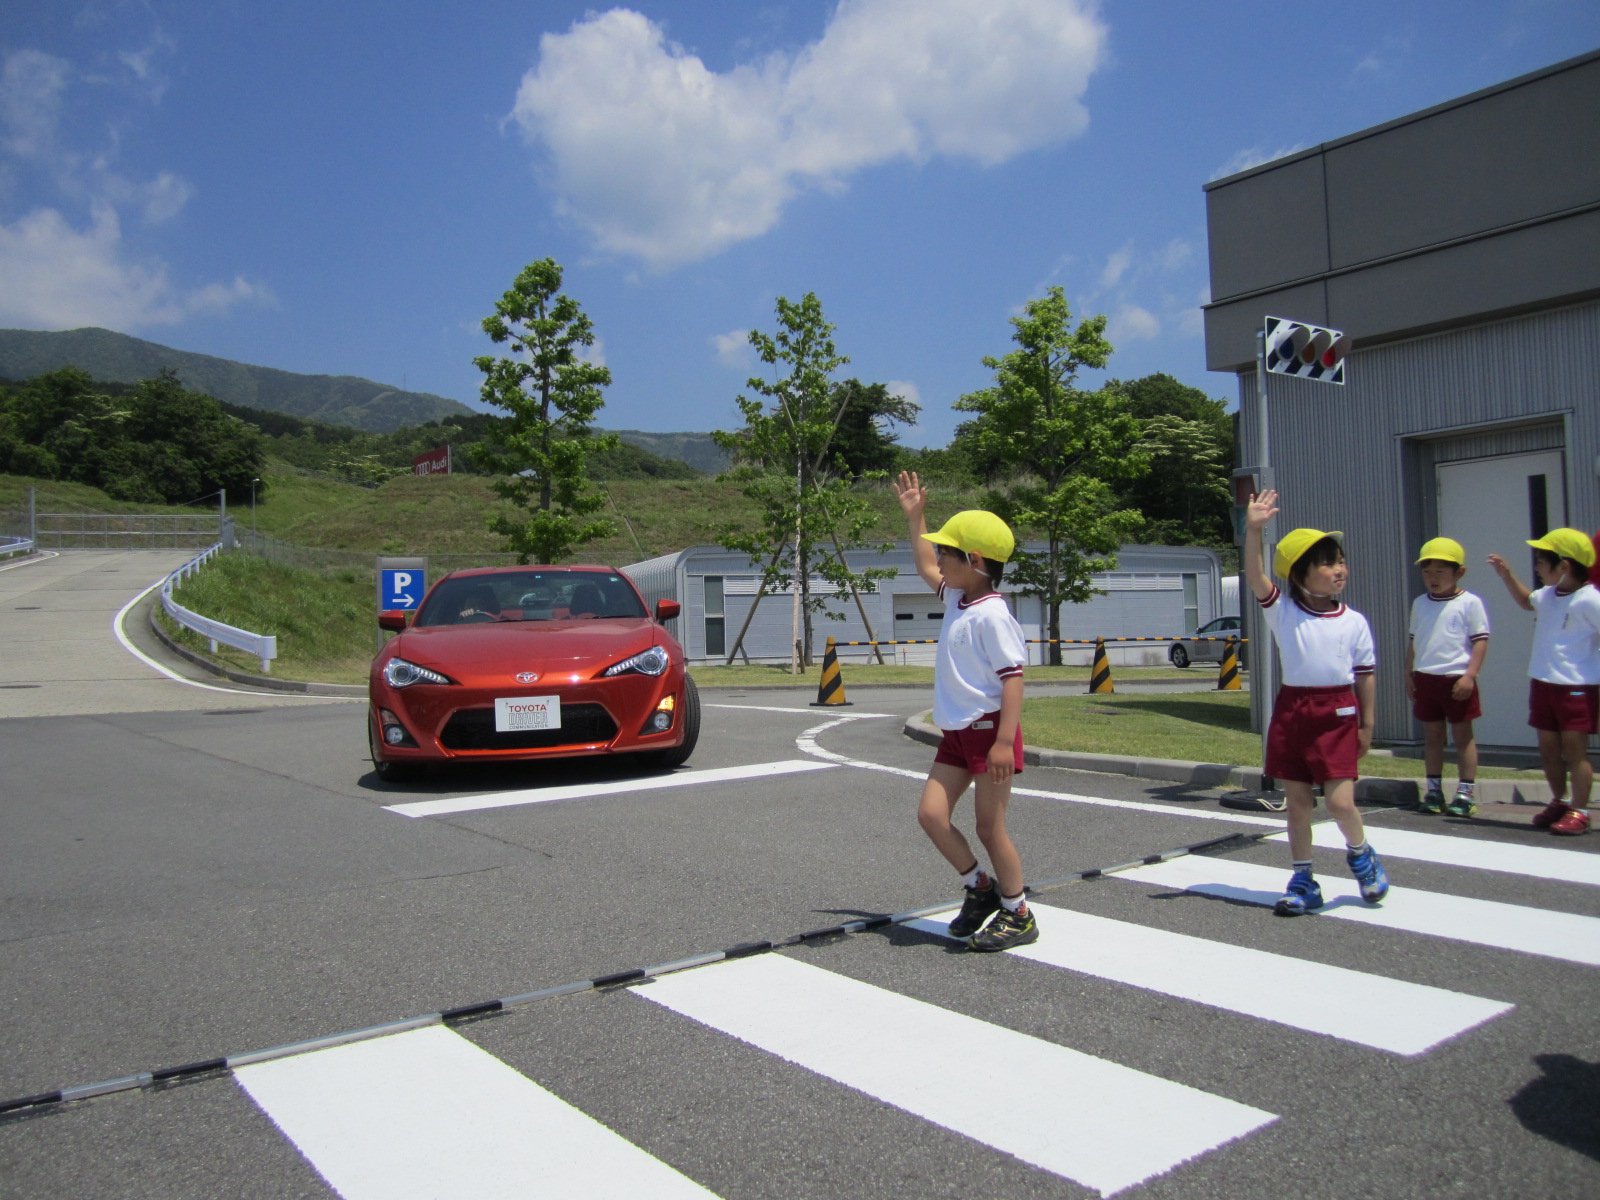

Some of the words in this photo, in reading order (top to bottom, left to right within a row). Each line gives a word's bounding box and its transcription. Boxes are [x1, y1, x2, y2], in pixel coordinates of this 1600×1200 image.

[394, 572, 412, 594] P
[508, 704, 547, 712] TOYOTA
[508, 712, 548, 725] DRIVER
